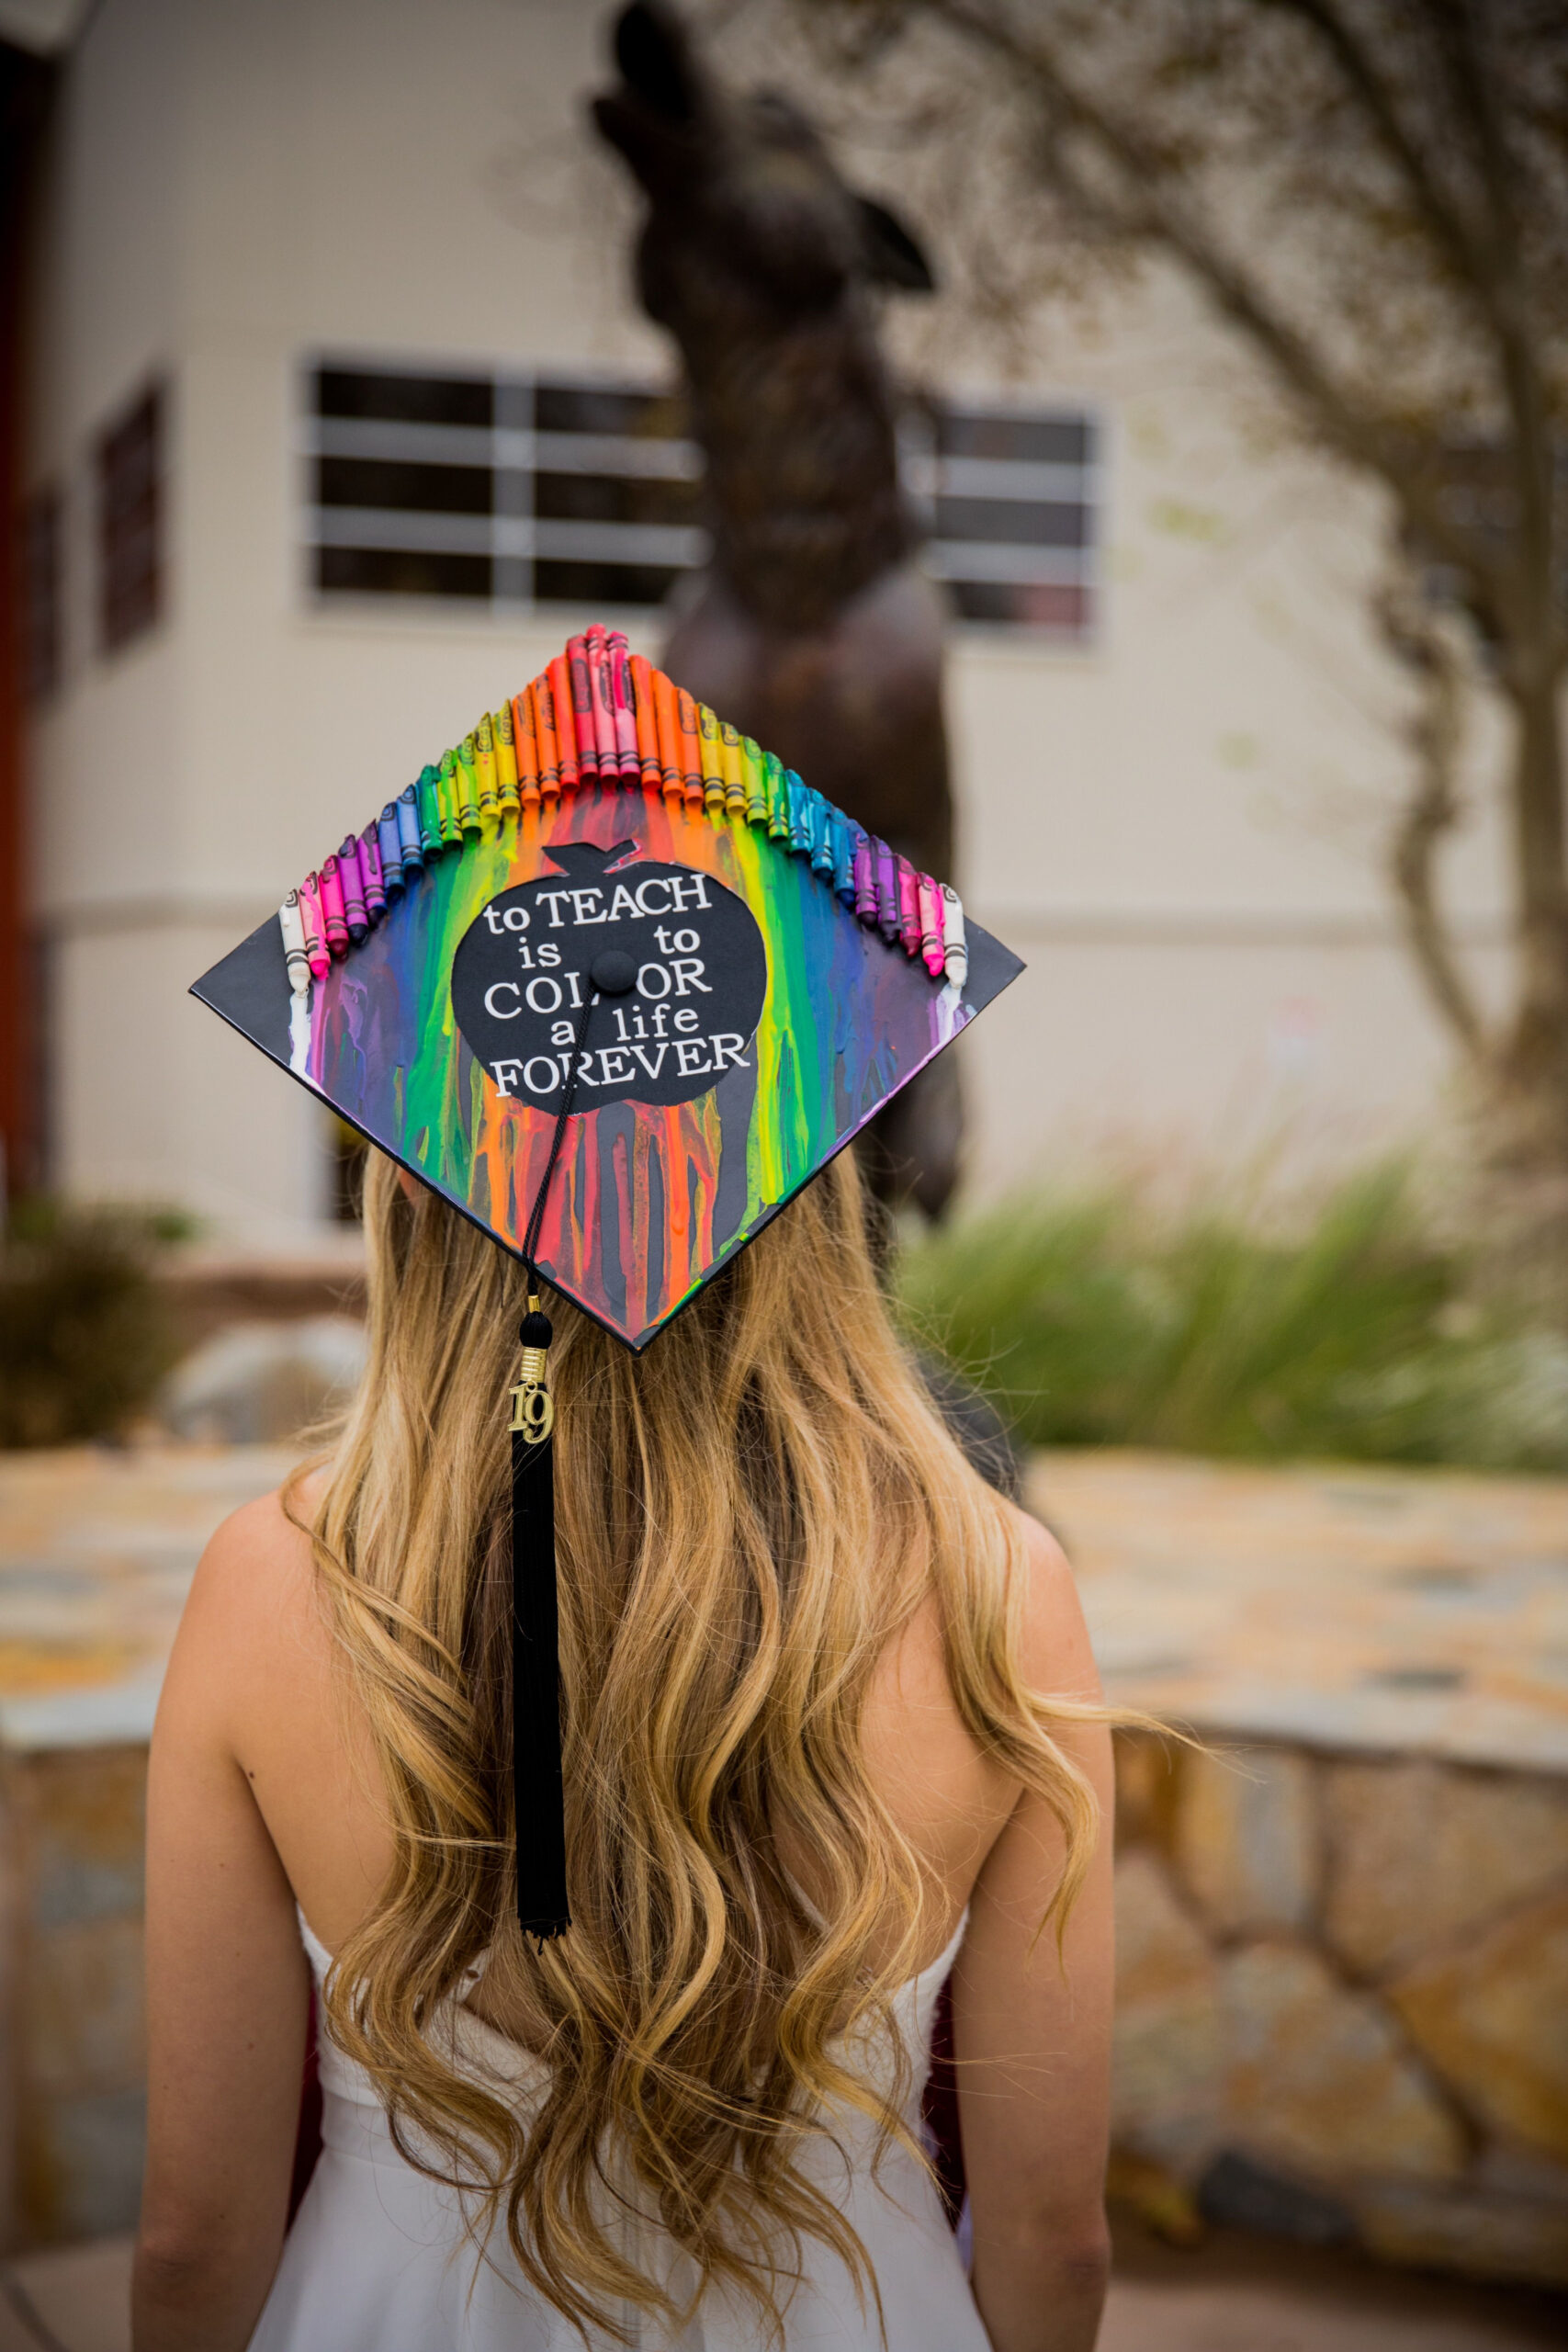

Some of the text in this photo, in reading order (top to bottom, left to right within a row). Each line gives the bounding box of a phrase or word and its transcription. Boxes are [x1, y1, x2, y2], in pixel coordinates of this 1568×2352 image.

[483, 874, 712, 934] to TEACH
[518, 925, 700, 969] is to
[550, 1003, 699, 1046] a life
[490, 1034, 750, 1098] FOREVER
[507, 1383, 554, 1444] 19
